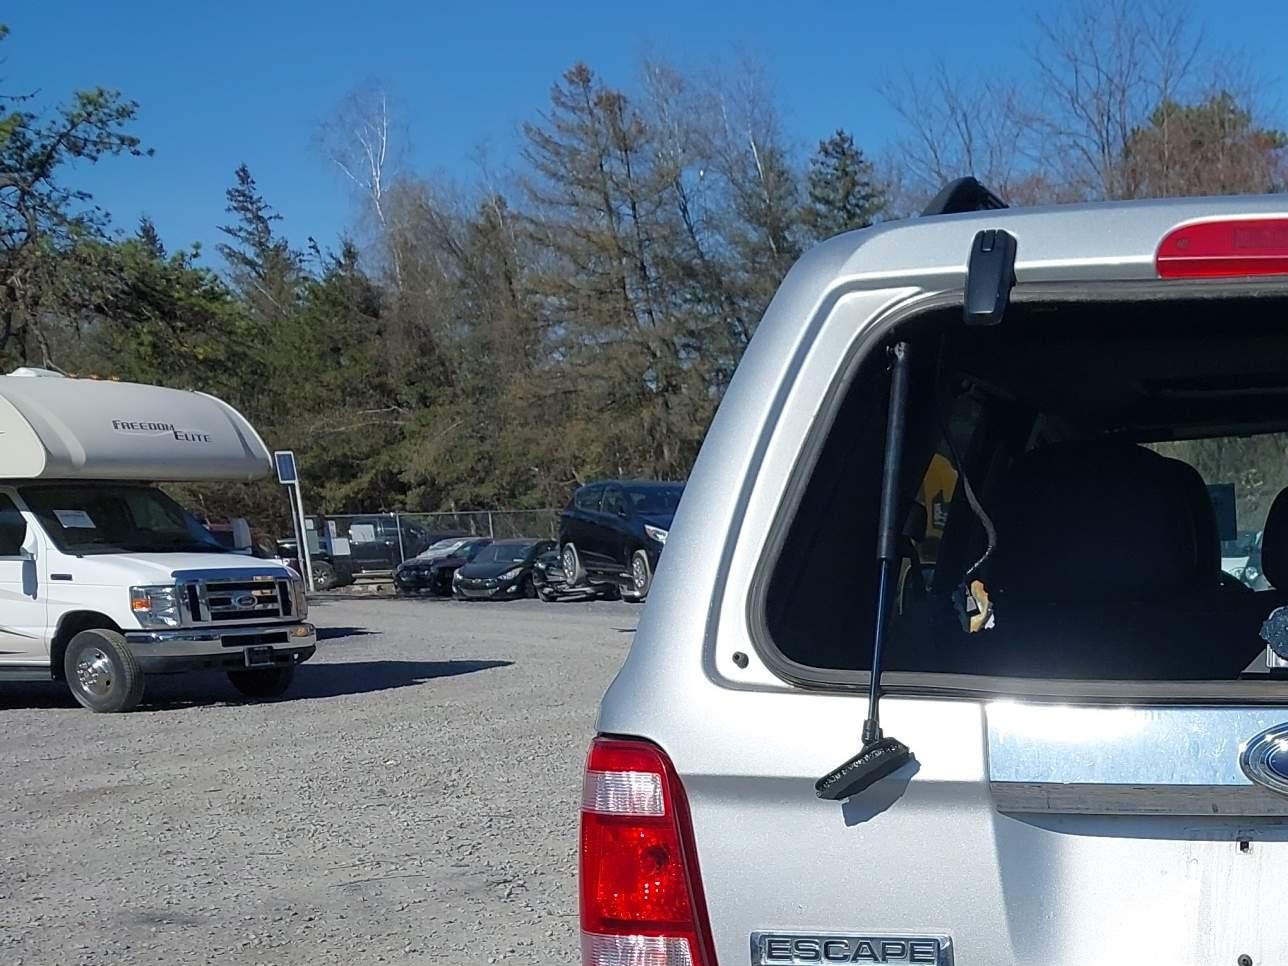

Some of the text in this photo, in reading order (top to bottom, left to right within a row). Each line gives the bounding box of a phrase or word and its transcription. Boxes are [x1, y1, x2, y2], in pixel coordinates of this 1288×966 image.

[111, 419, 175, 432] FREEDOM
[173, 430, 213, 443] ELITE
[766, 938, 936, 964] ESCAPE
